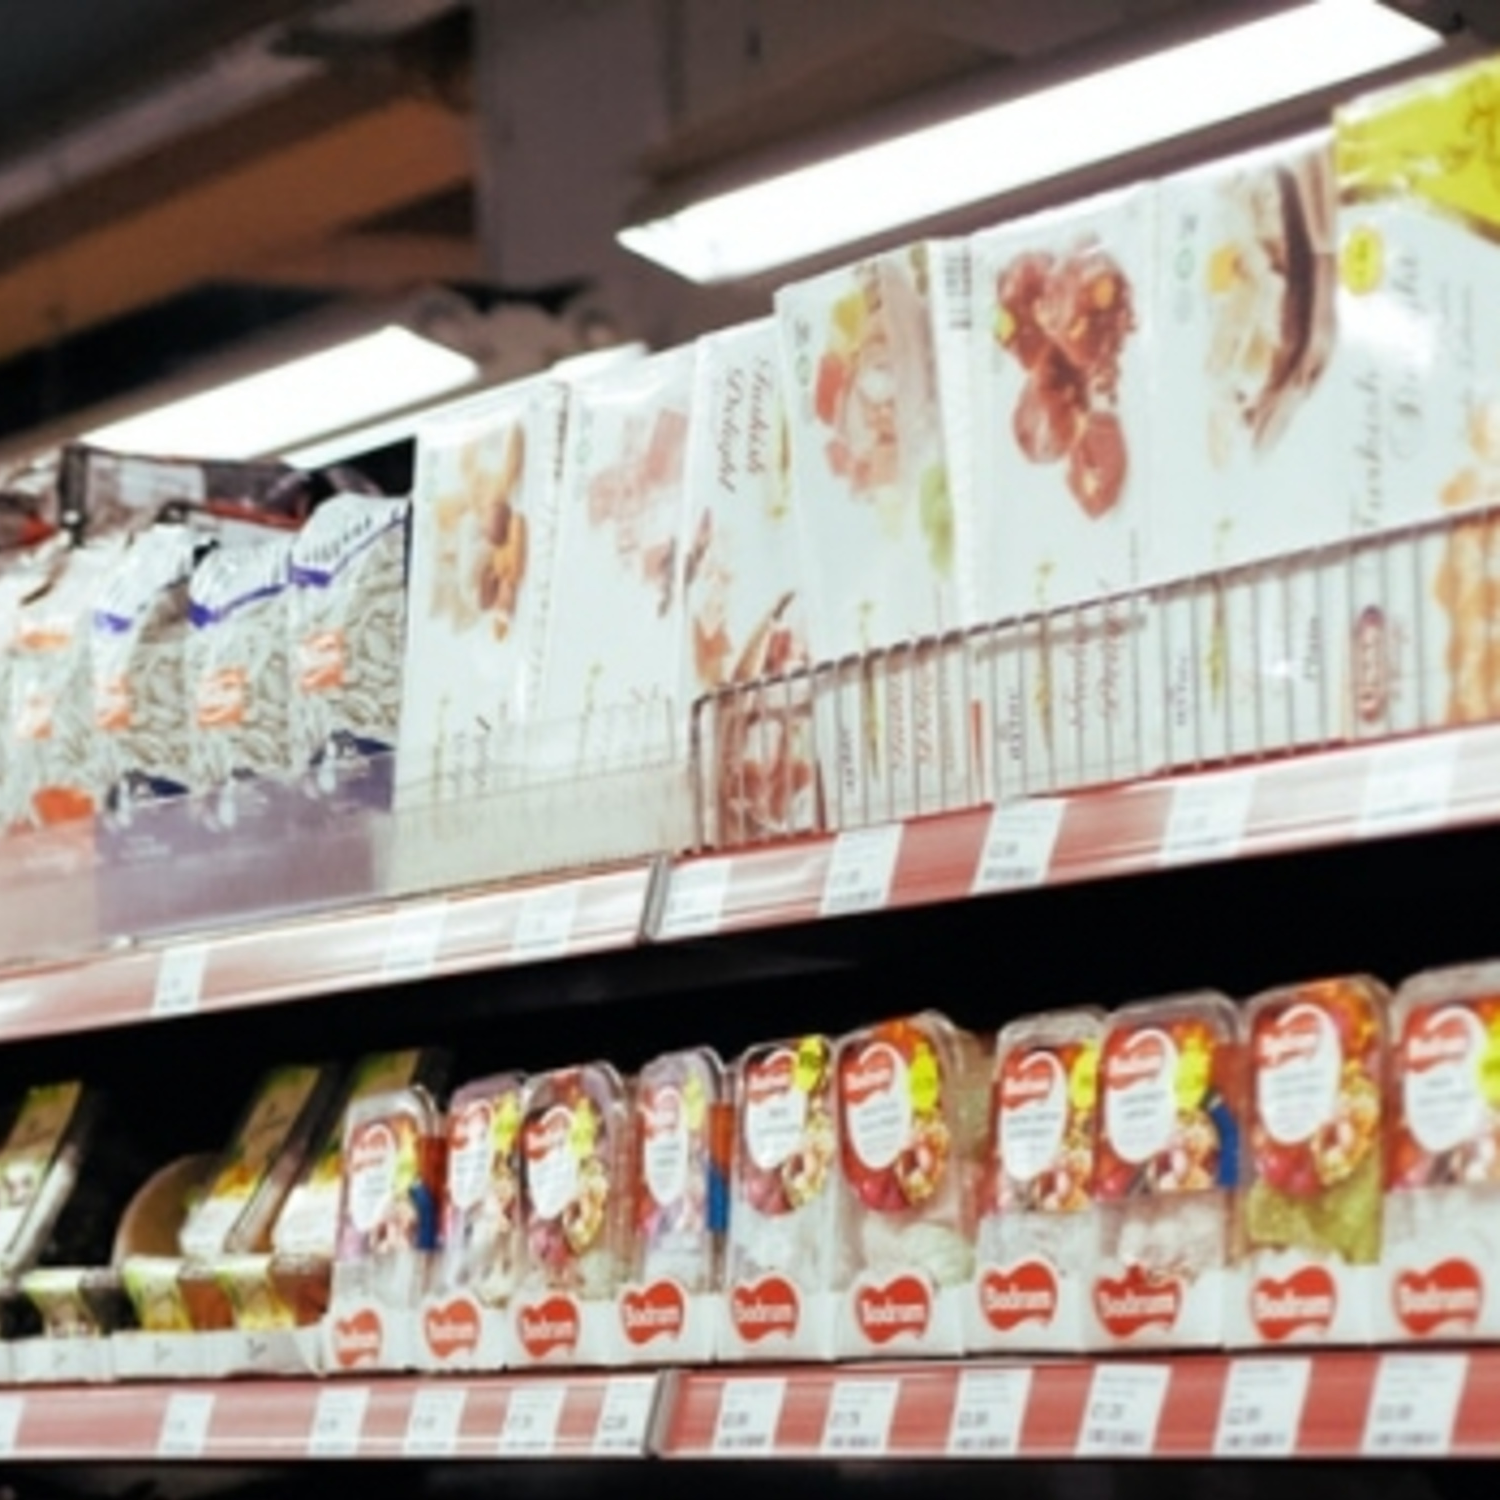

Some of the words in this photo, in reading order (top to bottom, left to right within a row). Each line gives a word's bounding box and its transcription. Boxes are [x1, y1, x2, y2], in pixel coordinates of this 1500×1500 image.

[860, 1296, 926, 1325] Bodrum
[985, 1283, 1051, 1311] Bodrum
[1098, 1288, 1176, 1317] Bodrum
[1255, 1287, 1329, 1319] Bodrum
[1400, 1280, 1478, 1313] Bodrum
